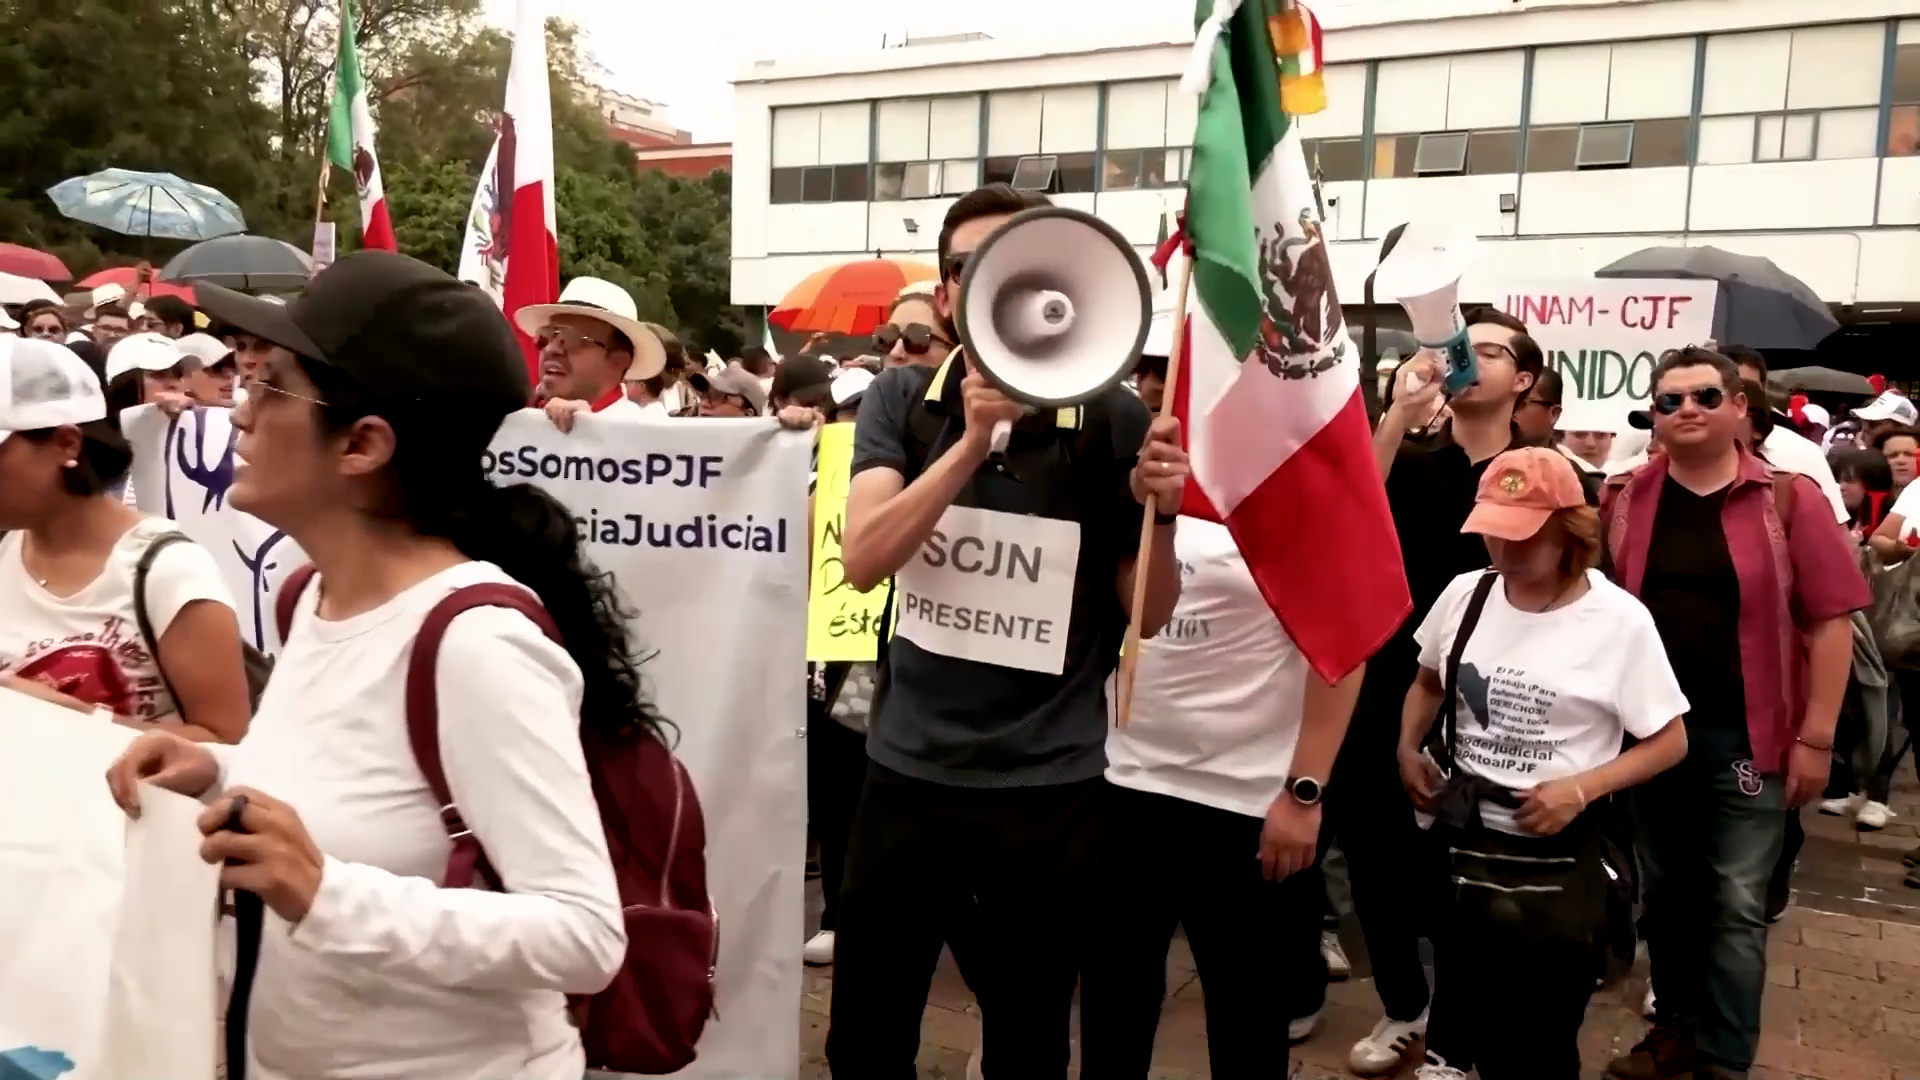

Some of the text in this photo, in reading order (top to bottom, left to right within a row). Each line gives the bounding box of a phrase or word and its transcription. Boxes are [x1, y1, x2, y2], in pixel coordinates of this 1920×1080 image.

[1620, 295, 1692, 331] CJF
[1548, 349, 1677, 401] NIDO
[922, 530, 1042, 583] SCJN
[906, 592, 1053, 644] PRESENTE
